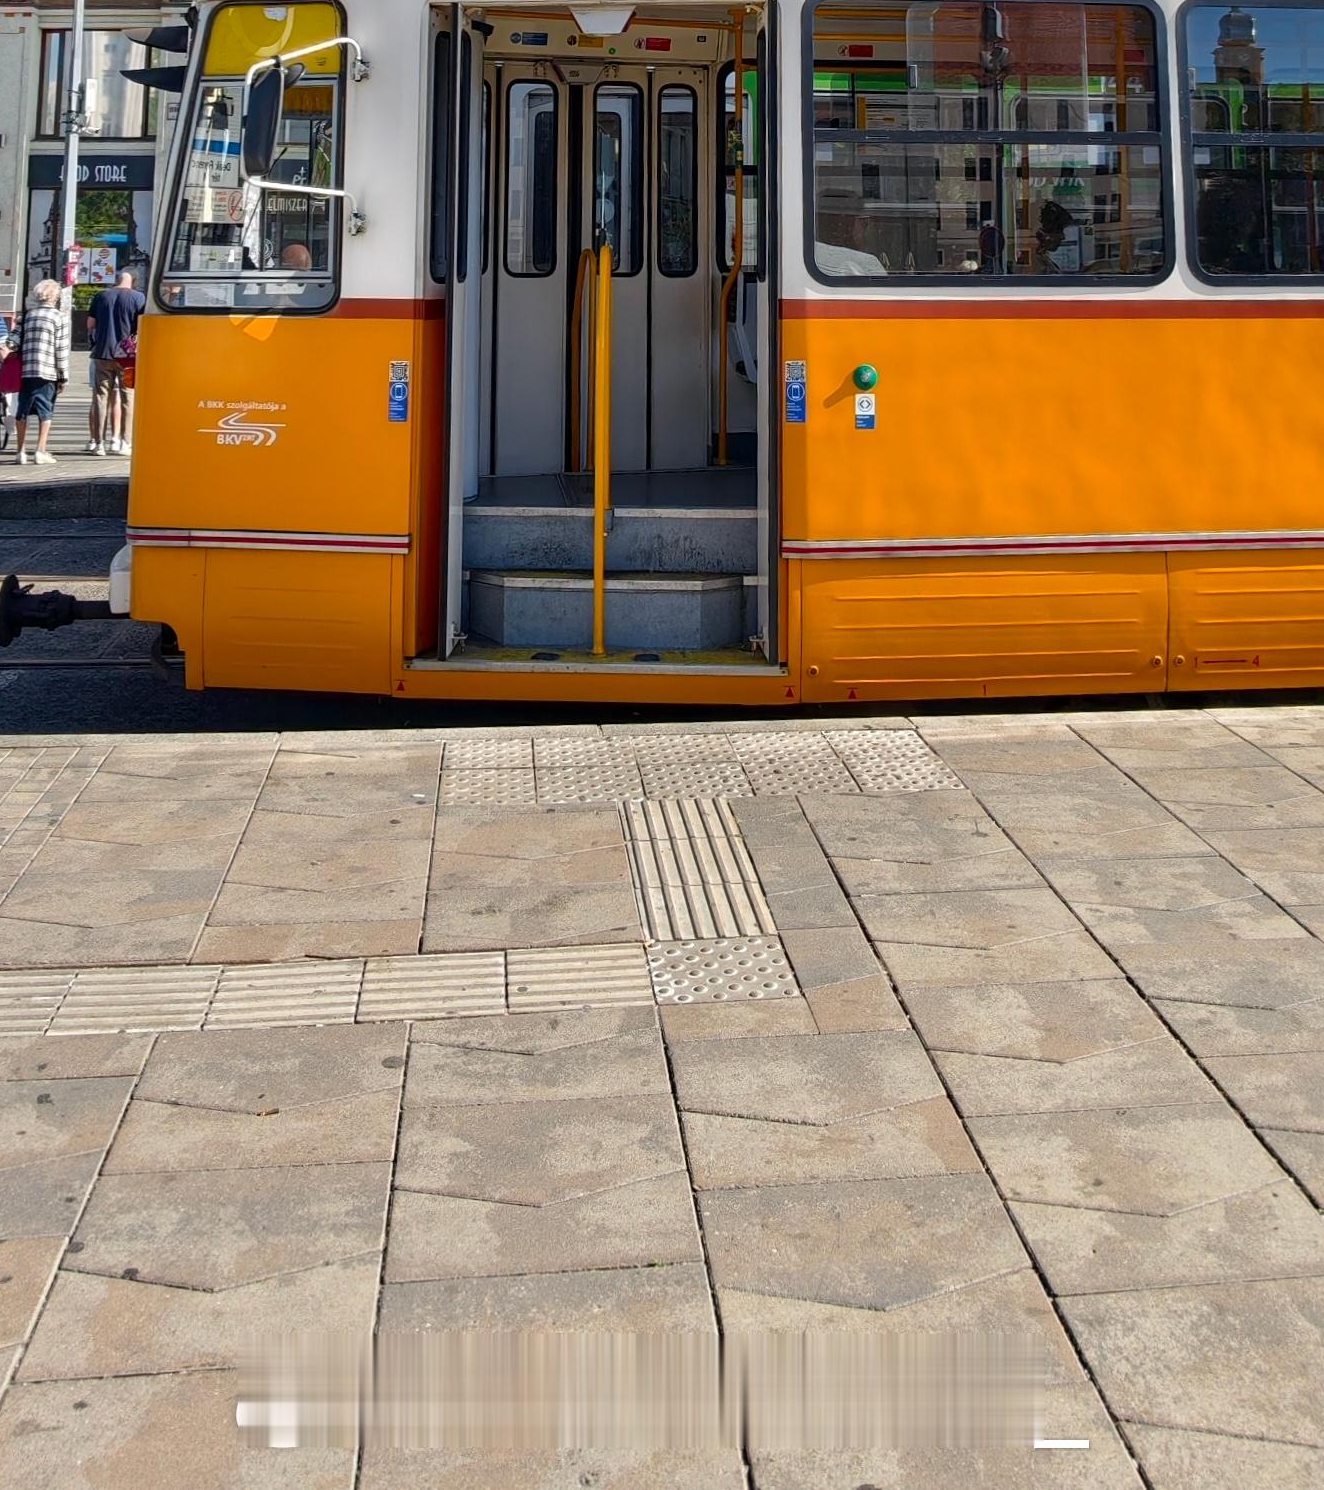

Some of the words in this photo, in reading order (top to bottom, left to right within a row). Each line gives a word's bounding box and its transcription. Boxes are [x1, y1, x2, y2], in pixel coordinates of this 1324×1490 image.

[95, 165, 127, 182] STORE
[197, 400, 205, 408] A
[207, 400, 224, 409] BKK
[226, 401, 279, 412] szolgáltatója
